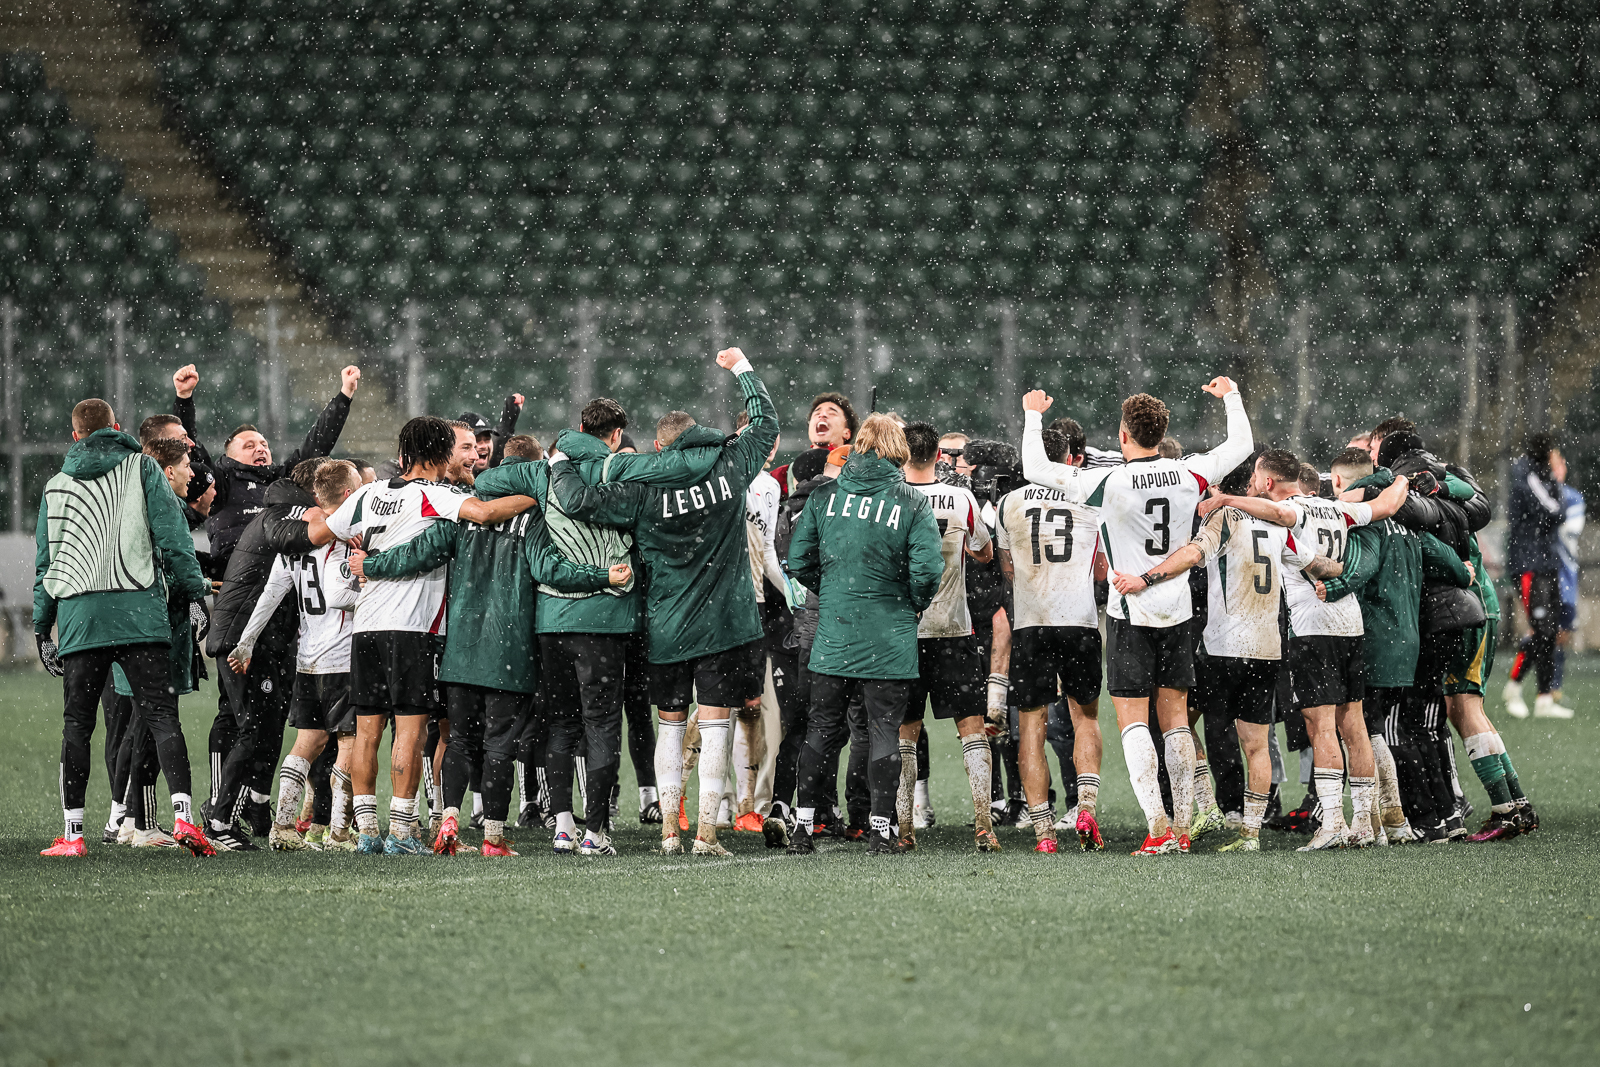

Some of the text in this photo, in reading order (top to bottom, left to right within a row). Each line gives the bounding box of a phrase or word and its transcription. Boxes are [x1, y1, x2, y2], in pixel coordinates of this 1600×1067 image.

[663, 476, 733, 518] LEGIA
[1132, 470, 1181, 490] KAPUADI
[826, 493, 902, 531] LEGIA
[925, 495, 955, 510] TKA
[1025, 508, 1073, 565] 13
[1144, 497, 1171, 556] 3
[1251, 530, 1272, 595] 5
[433, 653, 439, 680] 6
